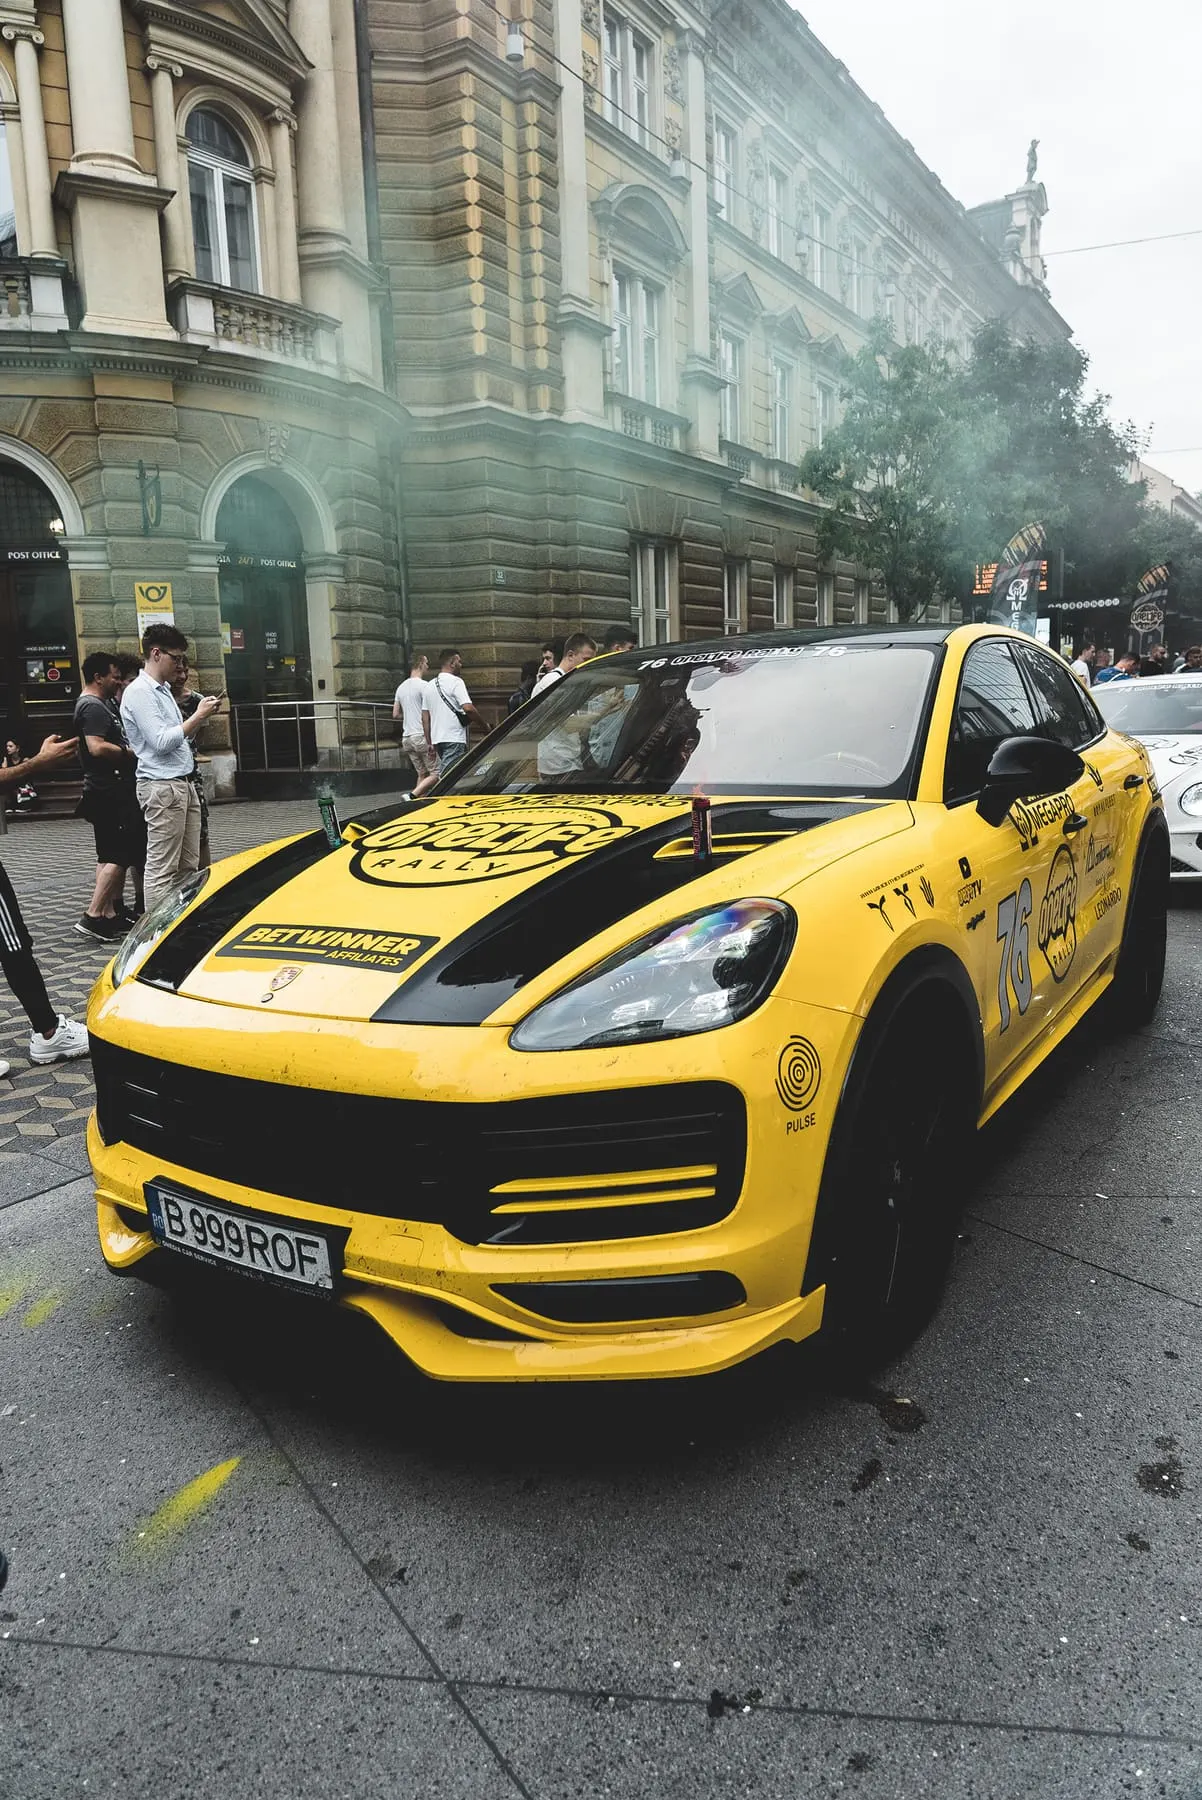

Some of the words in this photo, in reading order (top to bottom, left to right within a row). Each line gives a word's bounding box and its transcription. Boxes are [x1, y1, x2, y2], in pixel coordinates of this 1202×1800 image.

[8, 551, 30, 559] POST
[31, 551, 61, 559] OFFICE
[261, 558, 275, 566] POST
[277, 559, 296, 568] OFFICE
[637, 658, 668, 671] 76
[811, 645, 848, 657] 76
[1027, 793, 1075, 831] MEGAPRO
[370, 858, 510, 873] RALLY
[1093, 887, 1122, 921] LEONARDO
[242, 928, 421, 955] BETWINNER
[1052, 941, 1074, 964] RALLY
[325, 949, 403, 967] AFFILIATES
[997, 877, 1032, 1036] 76
[786, 1112, 816, 1136] PULSE
[152, 1212, 164, 1229] RO
[163, 1197, 186, 1237] B
[190, 1207, 244, 1258] 999
[245, 1223, 320, 1276] ROF
